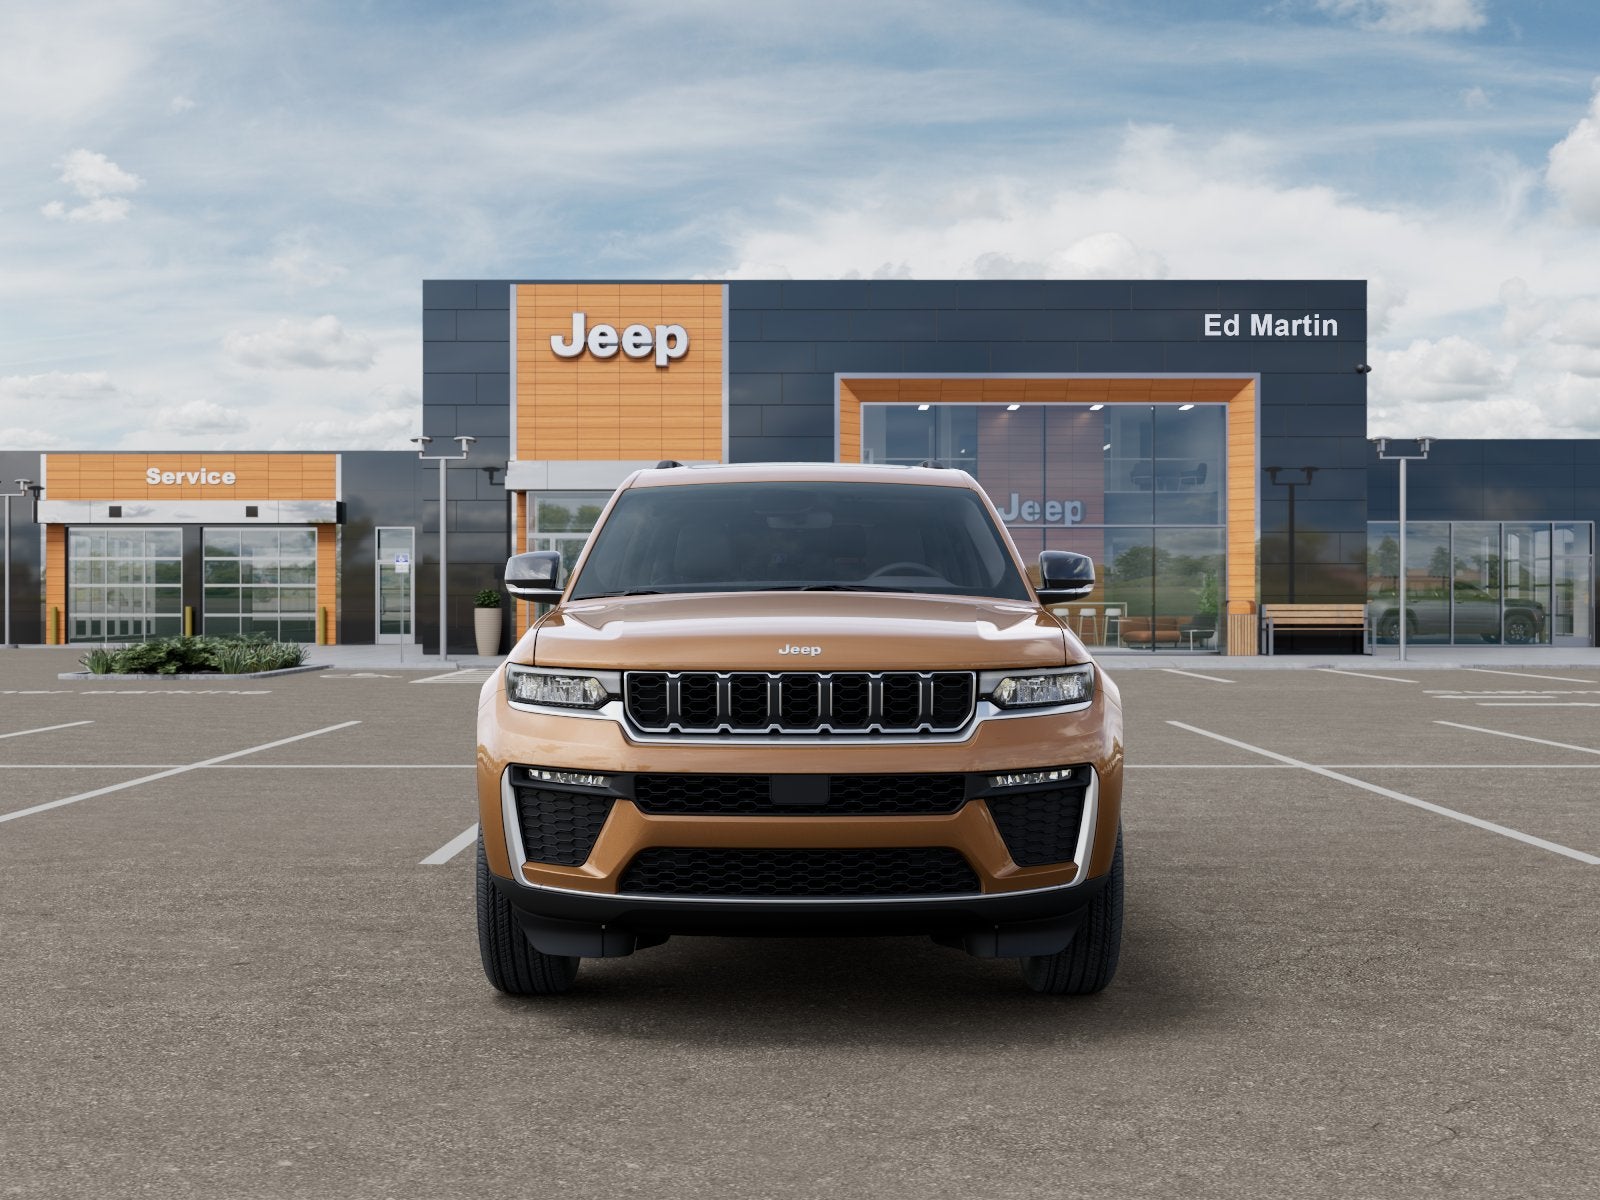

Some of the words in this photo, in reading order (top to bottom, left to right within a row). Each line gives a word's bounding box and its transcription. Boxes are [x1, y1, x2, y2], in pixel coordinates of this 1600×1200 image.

[1204, 313, 1239, 336] Ed
[1250, 313, 1338, 336] Martin
[550, 312, 688, 367] Jeep
[146, 467, 236, 485] Service
[997, 493, 1083, 526] Jeep
[778, 644, 821, 657] Jeep
